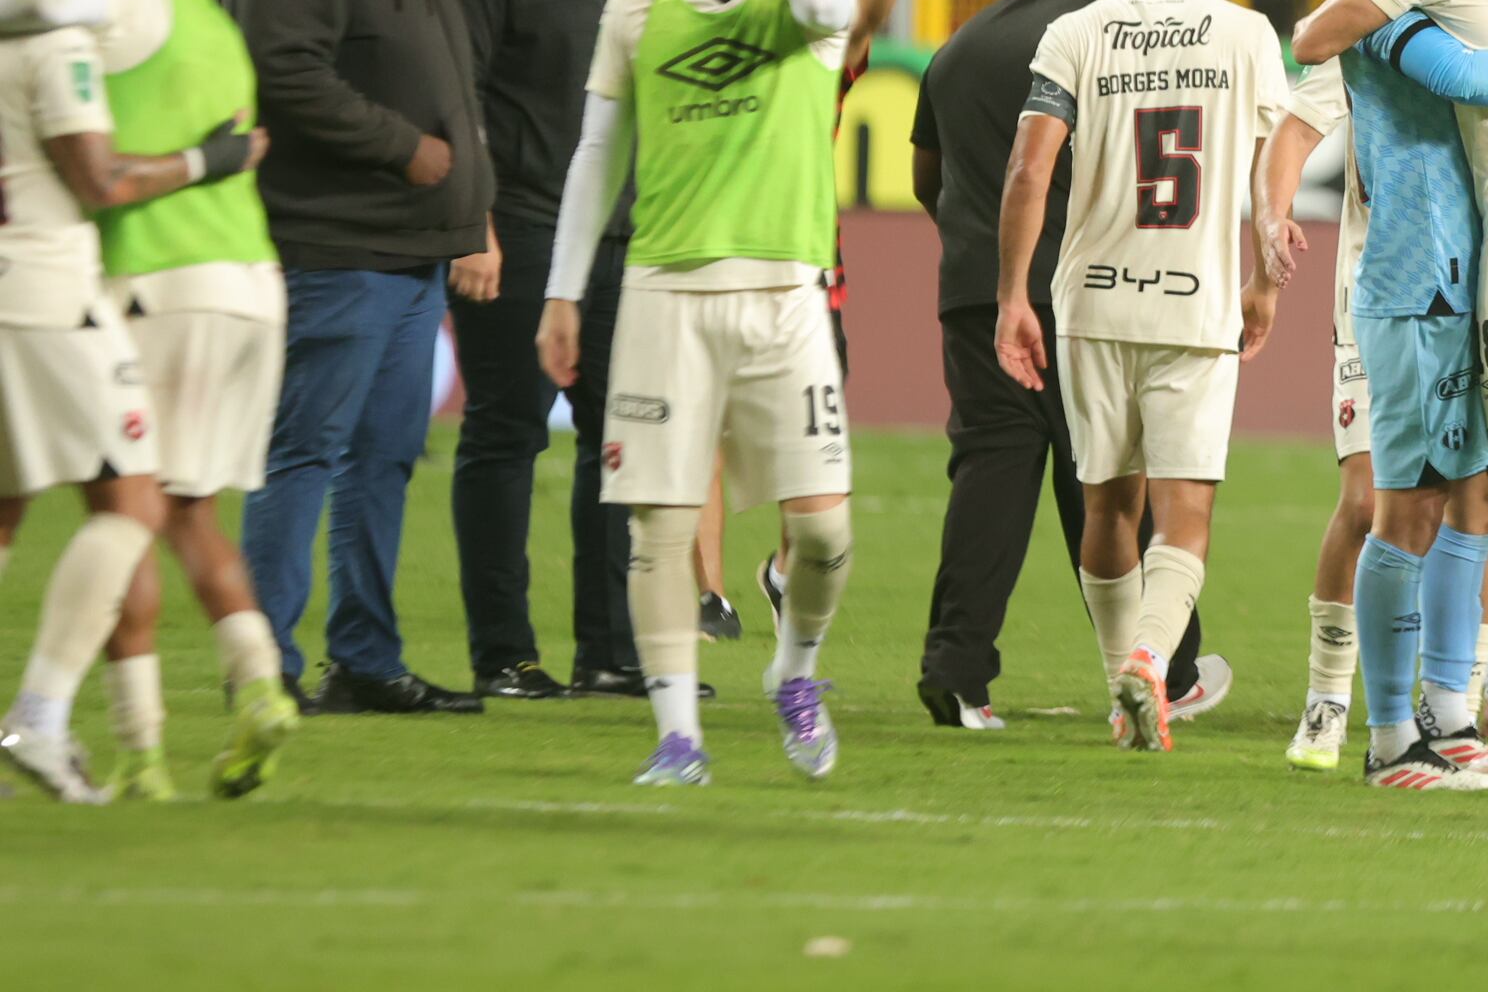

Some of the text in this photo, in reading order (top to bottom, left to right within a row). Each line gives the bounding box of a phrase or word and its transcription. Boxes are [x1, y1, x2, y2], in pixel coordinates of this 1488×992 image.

[1103, 14, 1212, 56] Tropical
[1096, 68, 1230, 97] BORGES MORA
[667, 95, 762, 124] umbro
[1134, 106, 1202, 230] 5
[1084, 264, 1200, 297] BYD
[802, 385, 841, 436] 15
